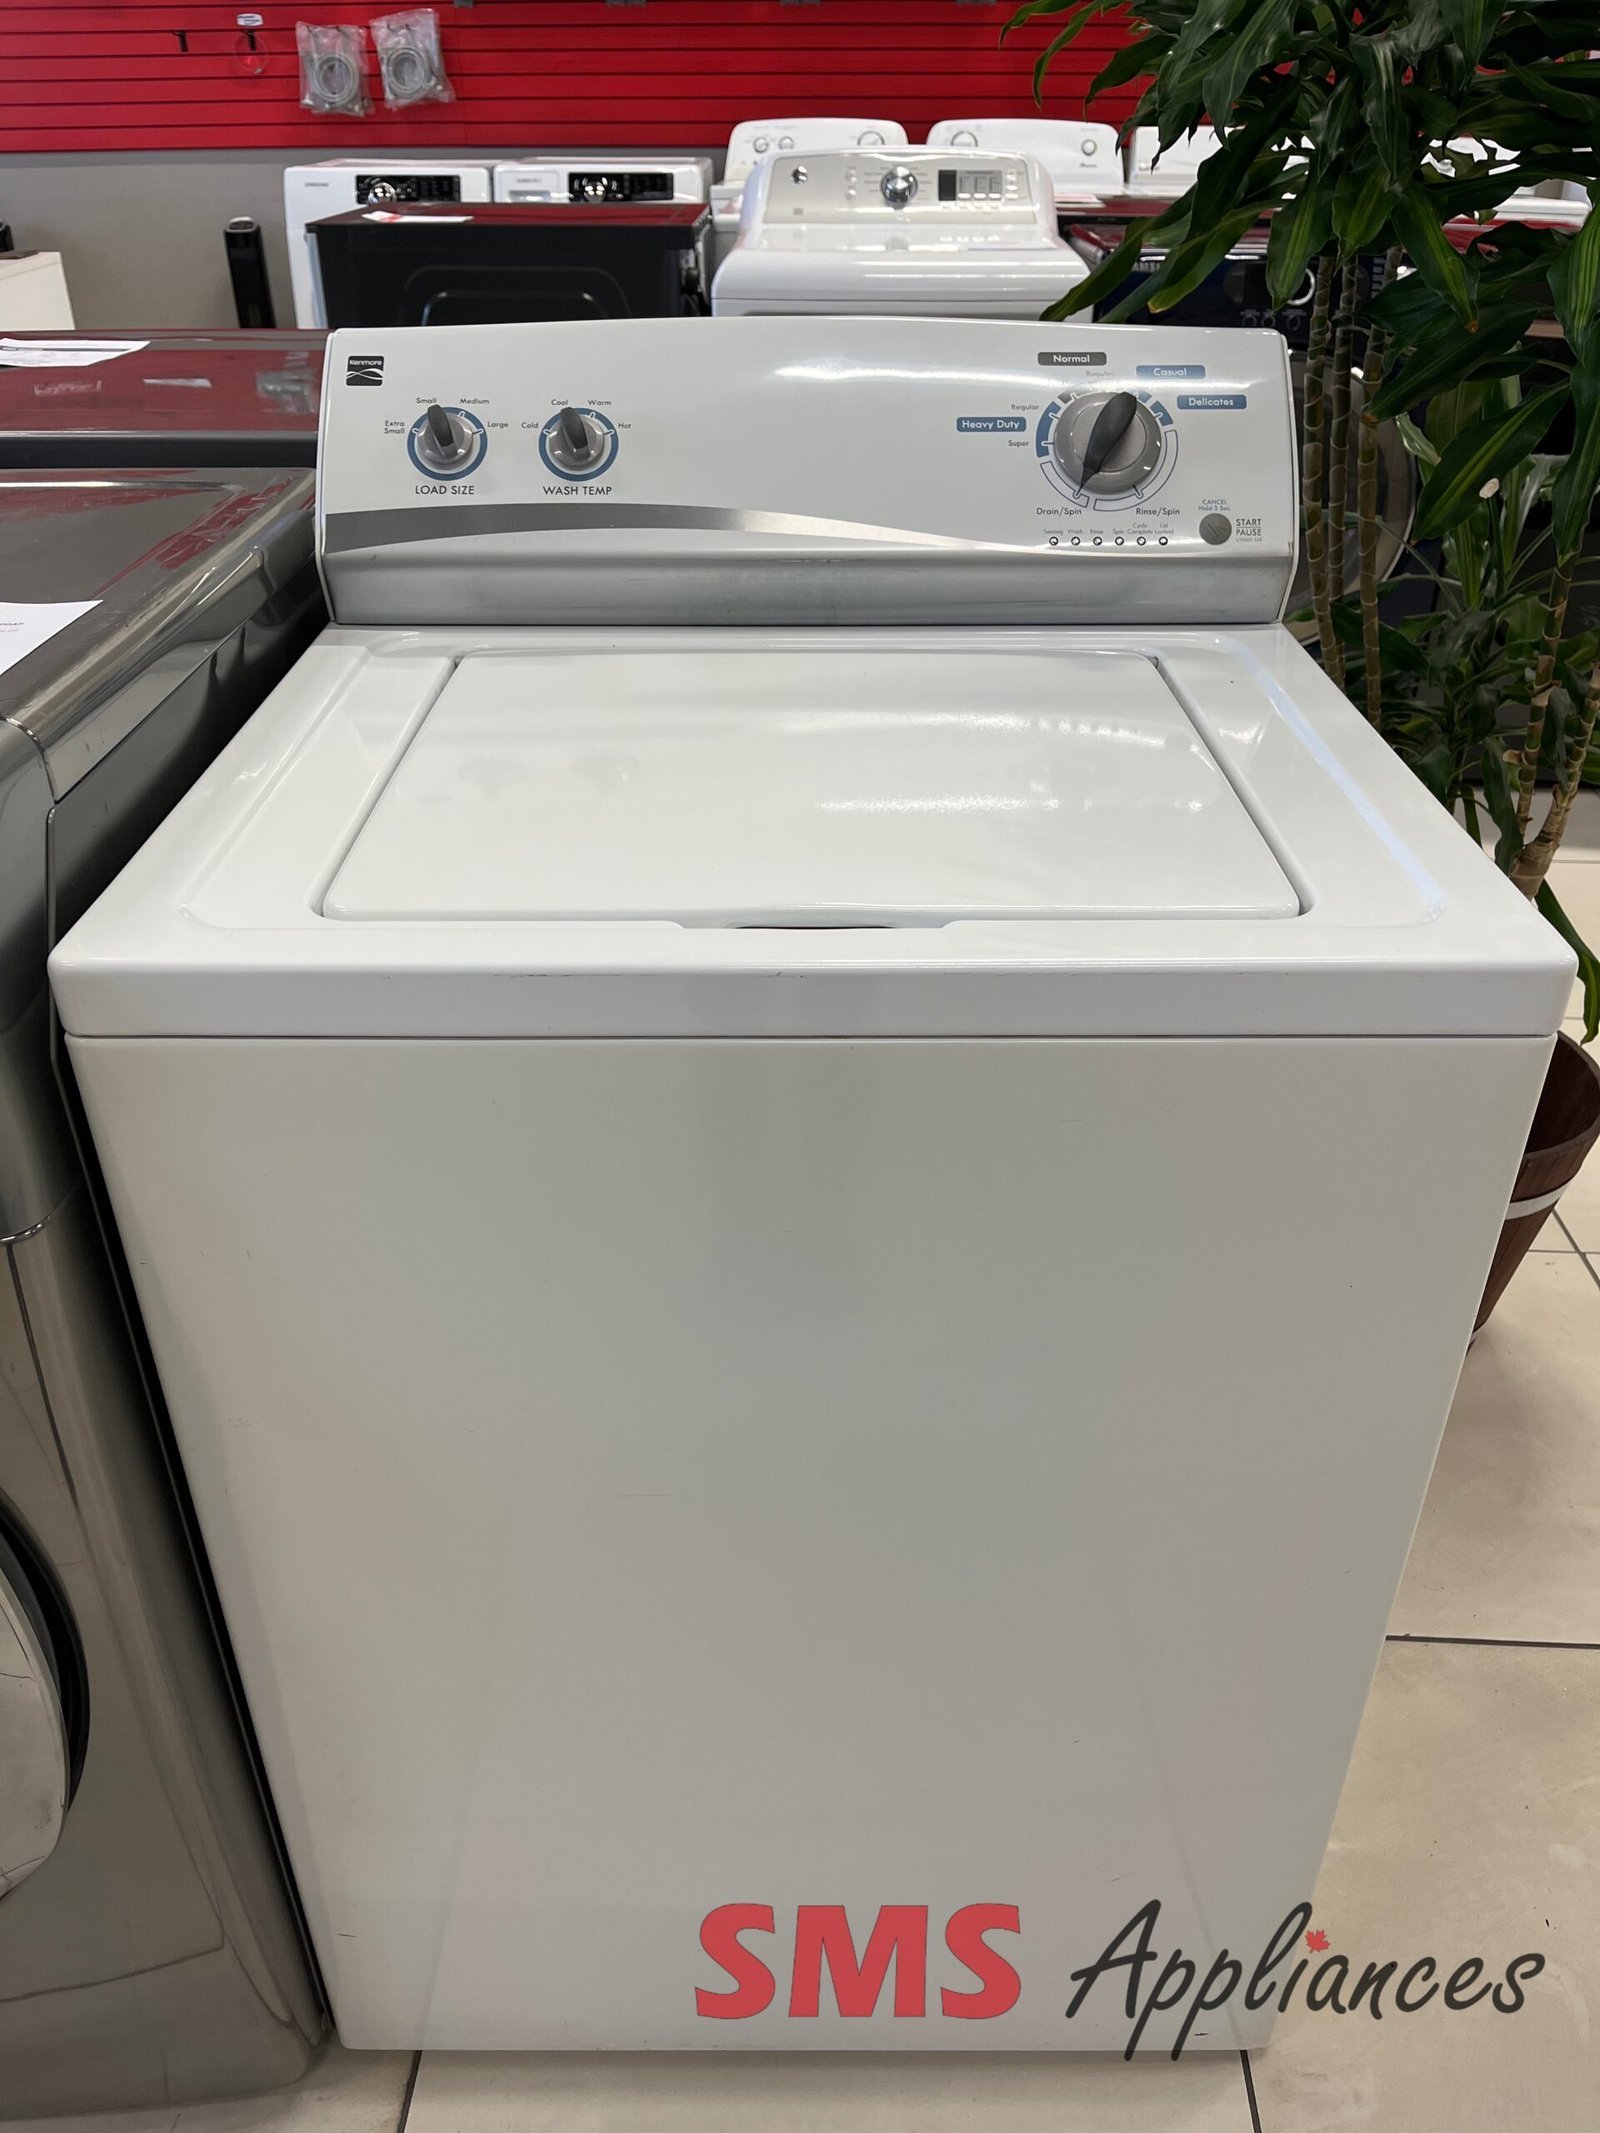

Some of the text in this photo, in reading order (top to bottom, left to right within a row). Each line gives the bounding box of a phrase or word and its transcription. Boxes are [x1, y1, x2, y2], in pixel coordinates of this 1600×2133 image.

[1053, 354, 1090, 363] Normal
[1153, 367, 1187, 376] Casual
[1188, 397, 1234, 406] Delicates
[1011, 404, 1039, 412] Regular
[487, 421, 509, 430] Large
[962, 419, 1020, 430] Heavy Duty
[1008, 440, 1030, 448] Super
[415, 485, 475, 495] LOAD SIZE
[543, 486, 613, 496] WASH TEMP
[1036, 507, 1082, 516] Drain/Spin
[1136, 507, 1181, 516] Rinse/Spin
[1236, 518, 1262, 526] START
[1236, 528, 1262, 536] PAUSE
